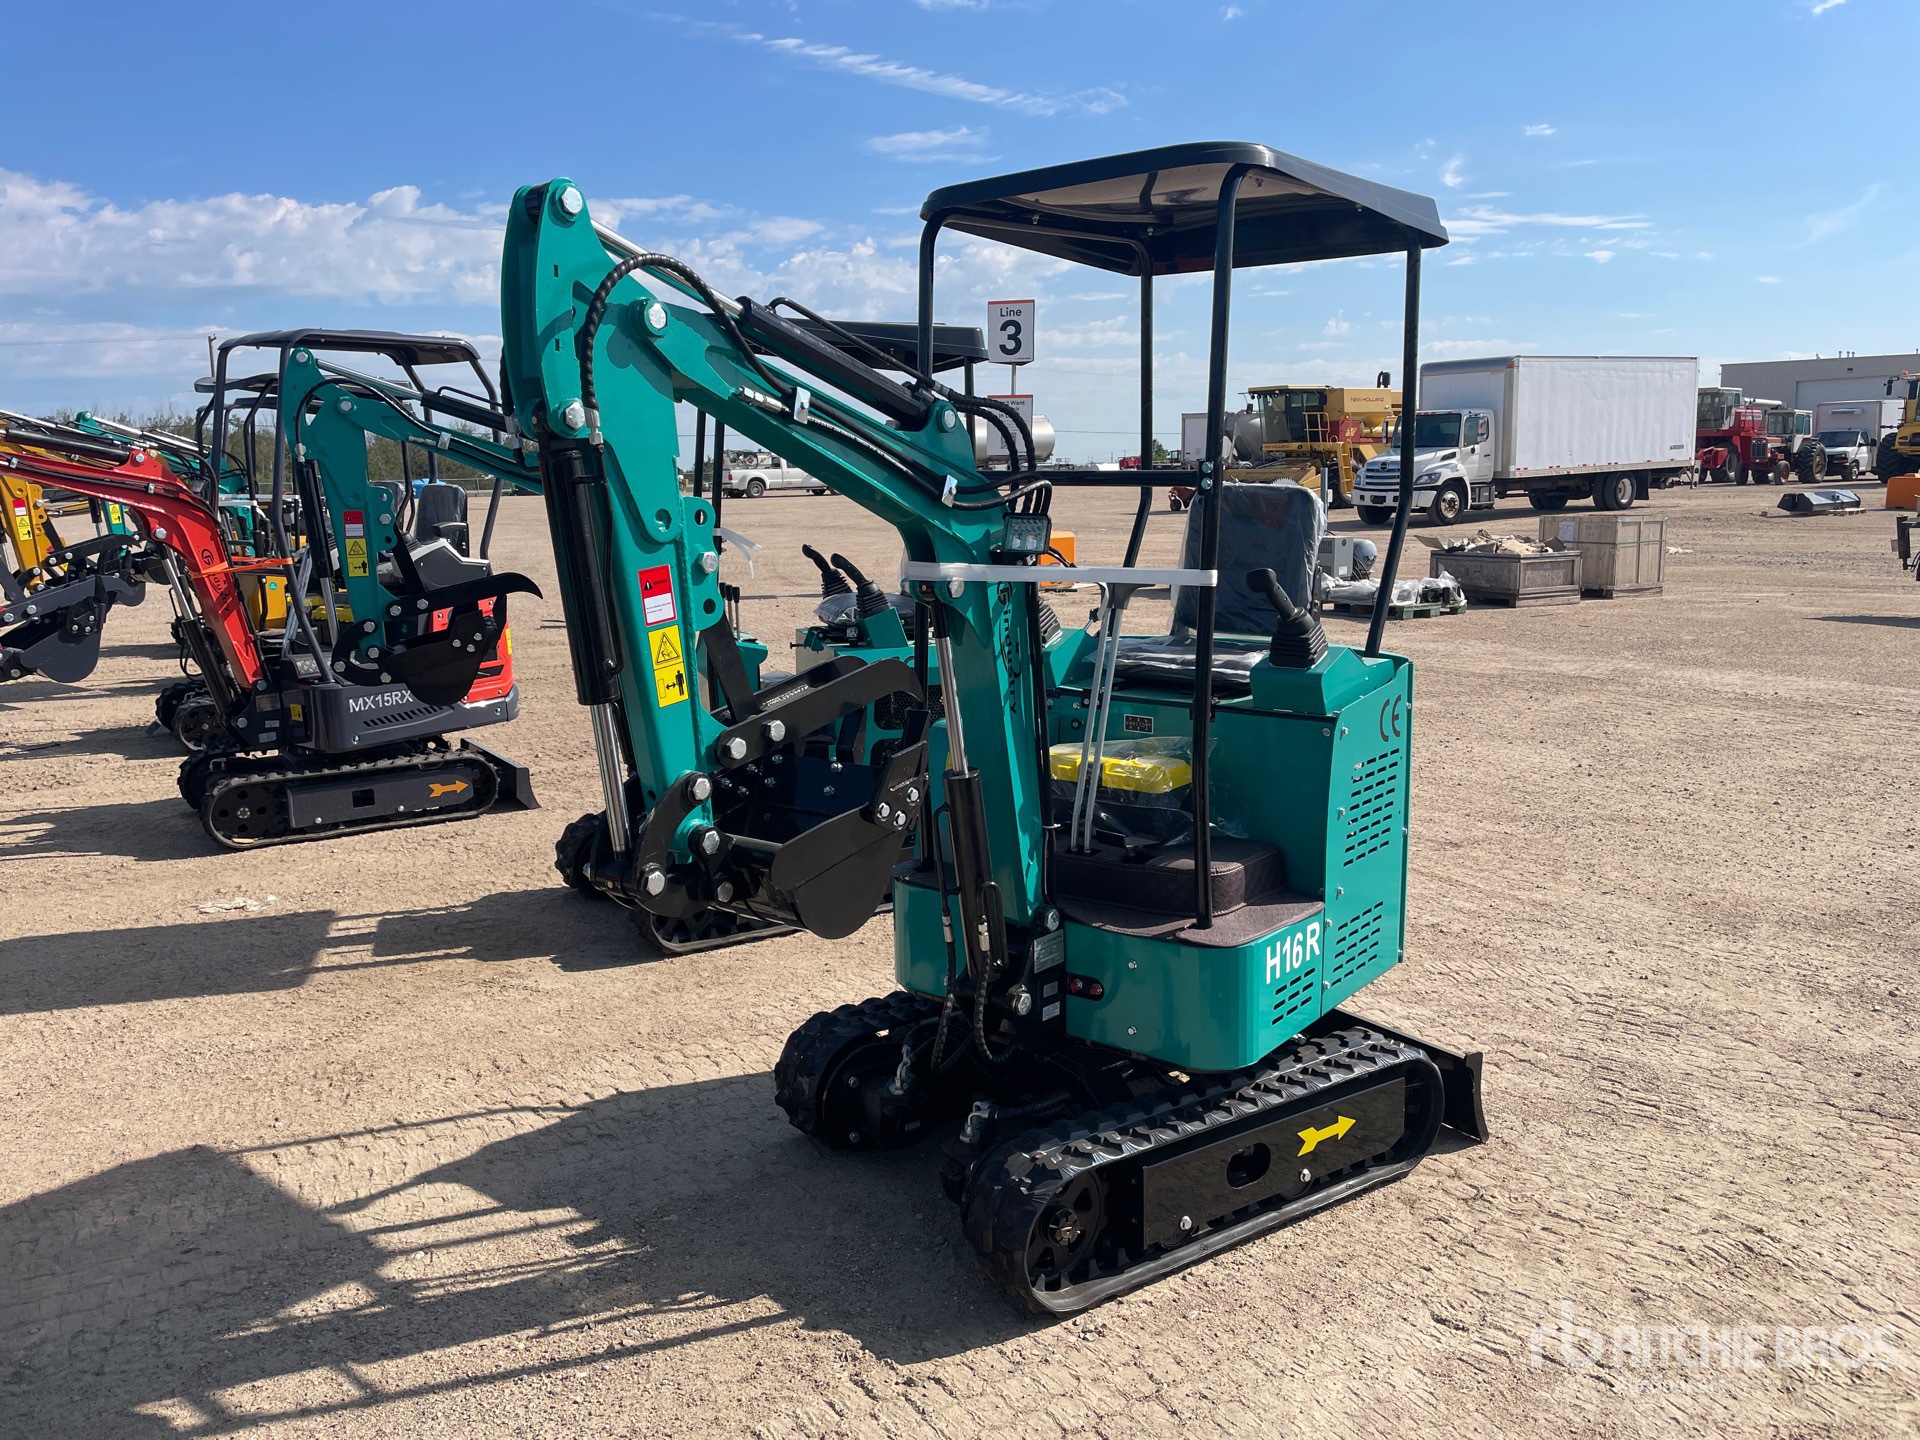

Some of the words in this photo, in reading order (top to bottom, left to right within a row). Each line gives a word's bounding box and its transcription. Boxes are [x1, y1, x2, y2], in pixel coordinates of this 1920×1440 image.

[1000, 308, 1022, 317] Line
[999, 319, 1022, 355] 3
[349, 690, 414, 713] MX15RX
[1266, 921, 1321, 985] H16R
